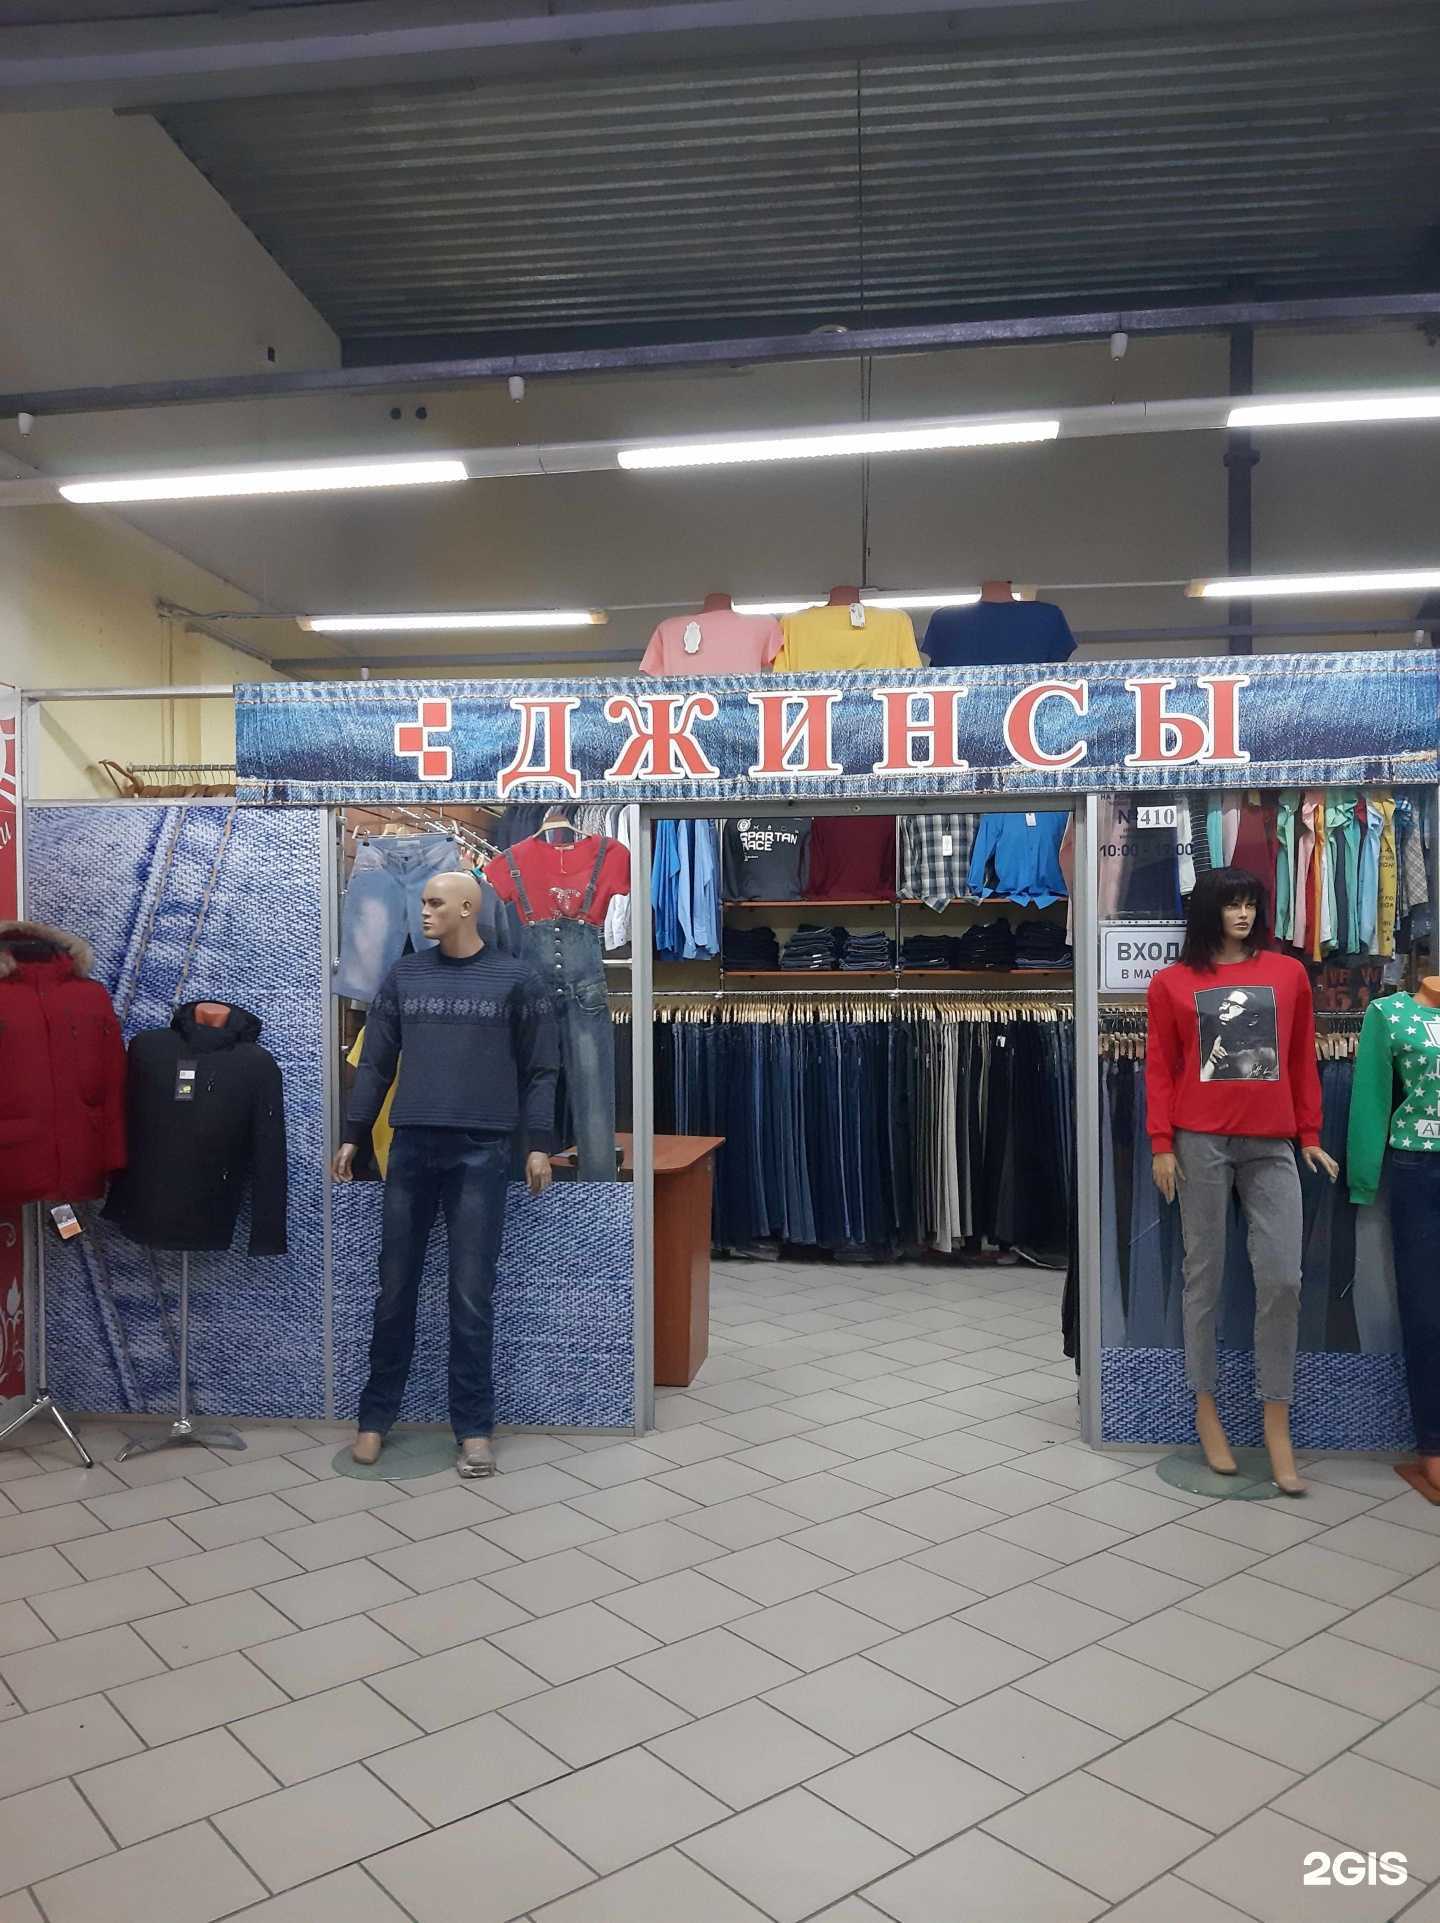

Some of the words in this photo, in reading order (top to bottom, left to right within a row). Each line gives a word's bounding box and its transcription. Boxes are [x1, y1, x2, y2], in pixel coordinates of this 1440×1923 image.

[497, 673, 1252, 800] ДЖИНСЫ
[1140, 808, 1175, 825] 410
[740, 831, 799, 845] SPARTAN
[1100, 844, 1138, 857] 10:00
[1117, 942, 1180, 964] ВХОД
[1121, 970, 1130, 979] В
